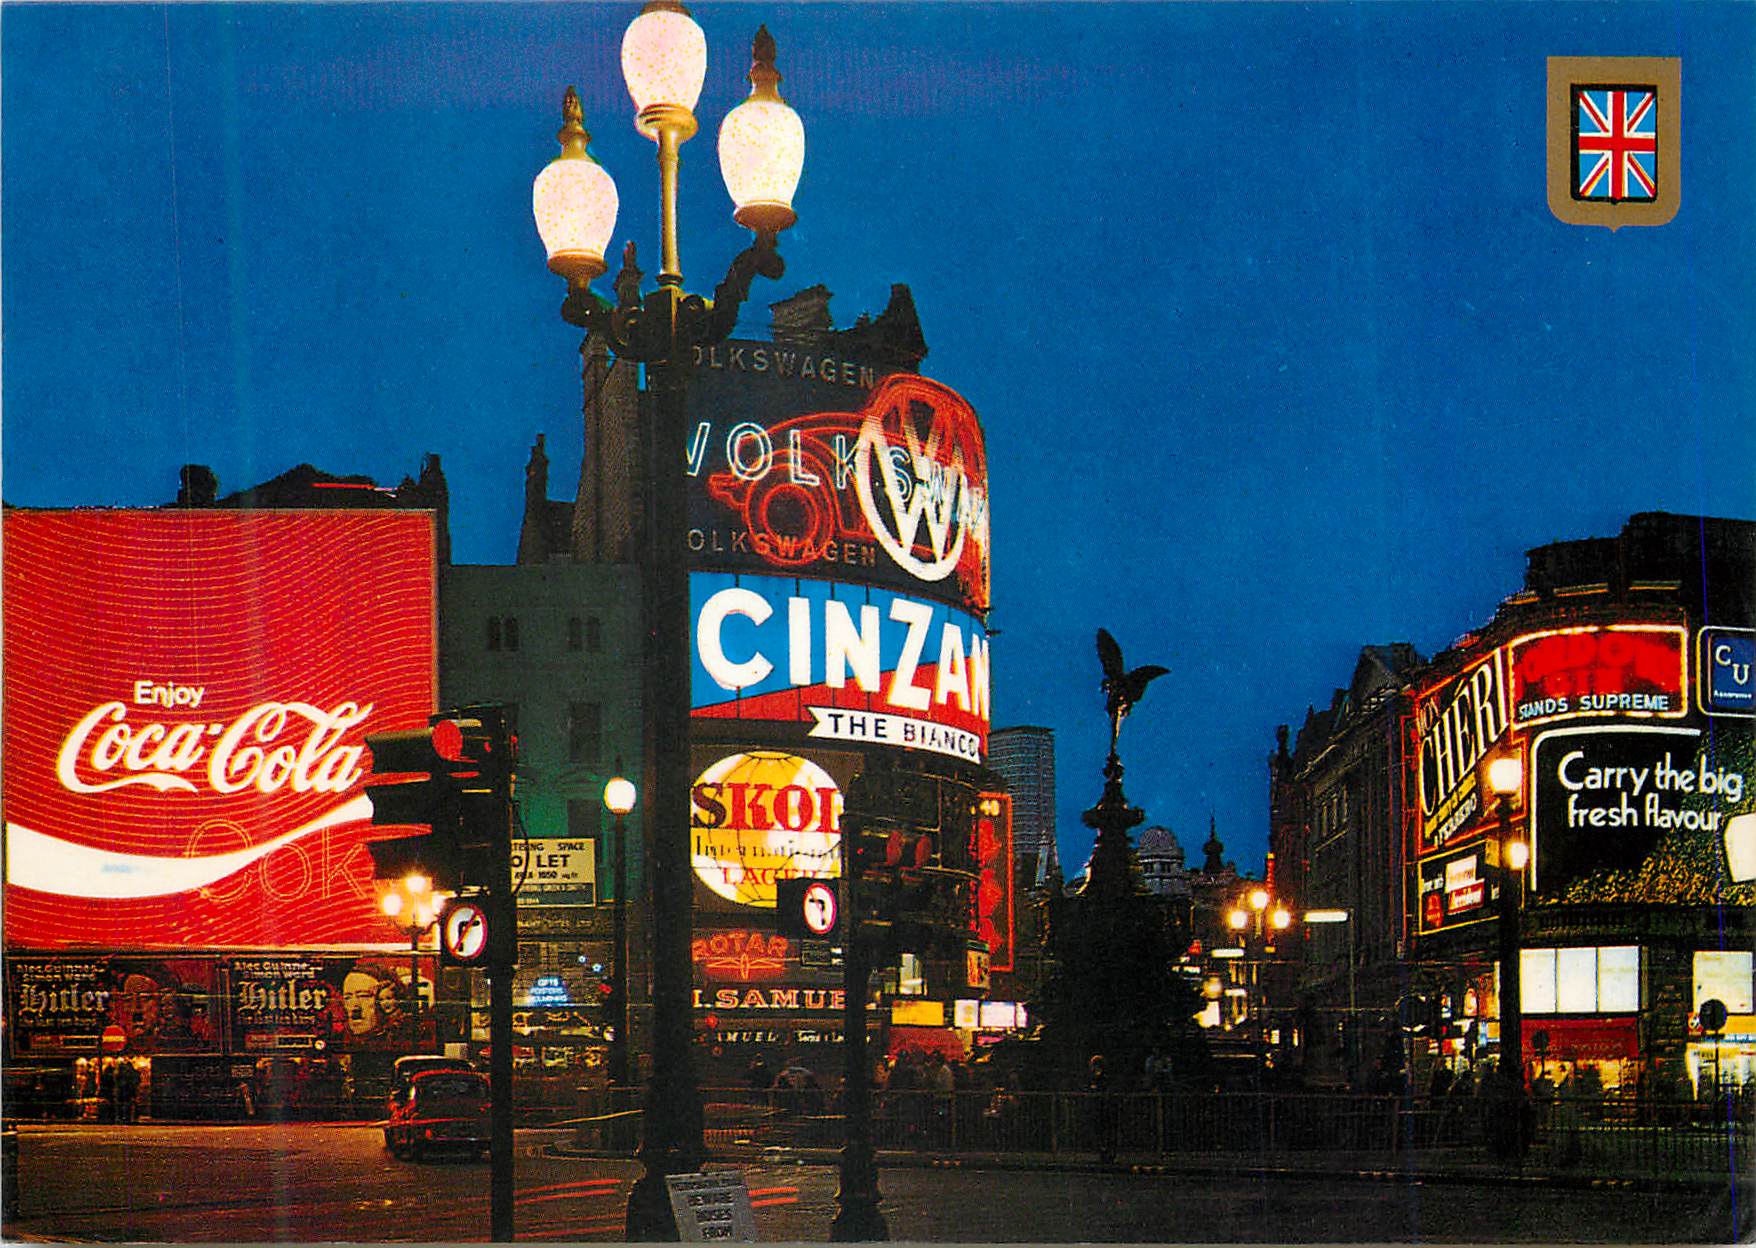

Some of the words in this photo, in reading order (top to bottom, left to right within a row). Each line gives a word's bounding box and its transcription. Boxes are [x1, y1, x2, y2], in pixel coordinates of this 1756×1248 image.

[692, 344, 875, 389] OLKSWAGEN
[688, 529, 876, 567] OLKSWAGEN
[134, 680, 205, 708] Enjoy
[1519, 697, 1569, 720] STANDS
[1580, 693, 1669, 711] SUPREME
[56, 701, 374, 793] Coca-Cola
[828, 713, 887, 738] THE
[903, 723, 977, 757] BIANCO
[1557, 751, 1649, 787] Carry
[1655, 752, 1696, 792] the
[1699, 753, 1744, 802] big
[1568, 791, 1639, 828] fresh
[1645, 792, 1723, 831] flavour
[511, 855, 523, 868] O
[536, 854, 570, 868] LET
[557, 842, 585, 851] SPACE
[19, 983, 109, 1016] Hitler
[238, 979, 327, 1011] Hitler
